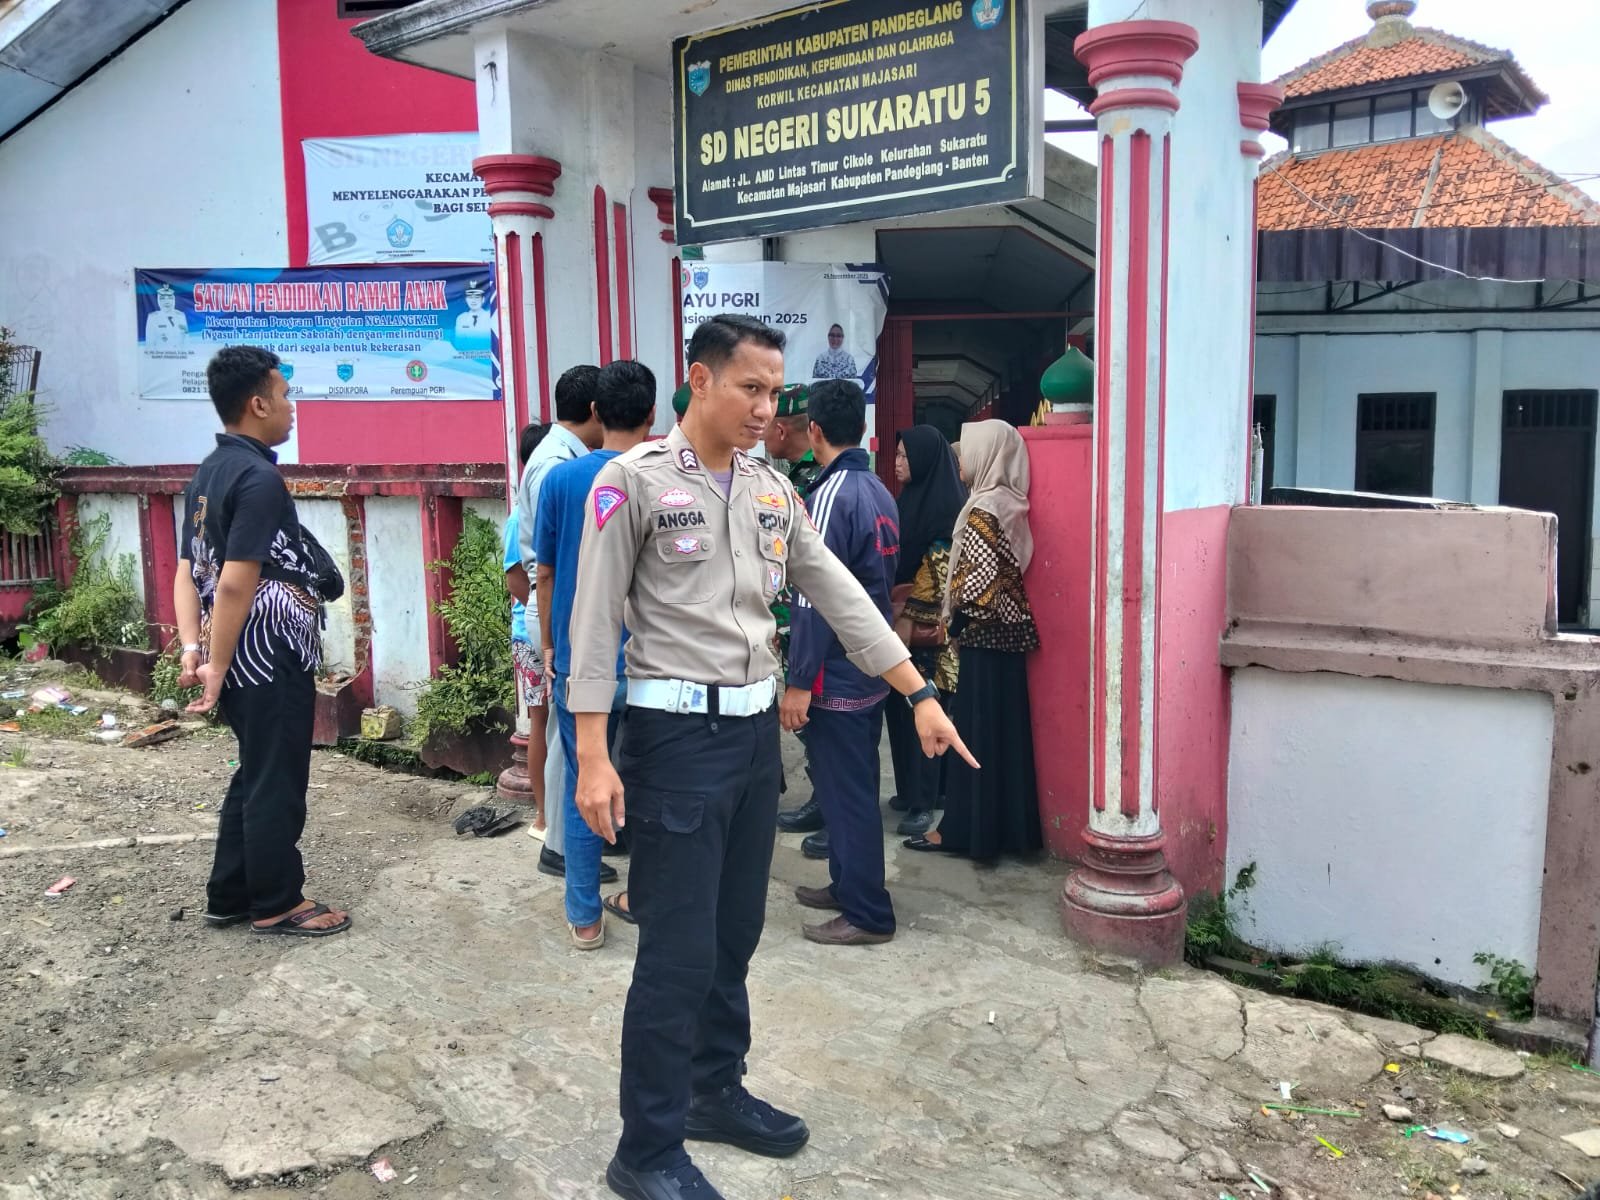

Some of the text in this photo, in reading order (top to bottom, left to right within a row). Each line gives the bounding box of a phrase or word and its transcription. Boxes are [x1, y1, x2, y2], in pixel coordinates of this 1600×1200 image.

[719, 1, 963, 73] PEMERINTAH KABUPATEN PANDEGLANG
[726, 31, 954, 94] DINAS PENDIDIKAN, KEPEMUDAAN DAN OLAHRAGA
[757, 63, 917, 109] KORWIL KECAMATAN MAJASARI
[700, 78, 991, 166] SD NEGERI SUKARATU 5
[702, 176, 731, 192] Alamat
[737, 173, 751, 187] JL.
[755, 167, 775, 183] AMD
[779, 165, 806, 180] Lintas
[811, 160, 839, 175] Timur
[881, 144, 932, 163] Kelurahan
[940, 133, 987, 153] Sukaratu
[737, 187, 785, 204] Kecamatan
[787, 178, 826, 198] Majasari
[831, 171, 882, 190] Kabupaten
[884, 162, 943, 181] Pandeglang
[952, 154, 989, 171] Banten
[333, 187, 491, 201] MENYELENGGARAKAN PE
[433, 203, 463, 213] BAGI
[194, 280, 448, 312] SATUAN PENDIDIKAN RAMAH ANAK
[684, 292, 760, 307] AYU PGRI
[206, 314, 438, 329] Mewujudkan Program Unggulan NGALANGKAH
[775, 313, 808, 324] 2025
[346, 329, 382, 340] dengan
[385, 328, 443, 340] melindungi
[278, 343, 297, 352] dari
[300, 343, 330, 353] segala
[333, 342, 368, 352] bentuk
[370, 342, 422, 352] kekerasan
[658, 511, 706, 529] ANGGA
